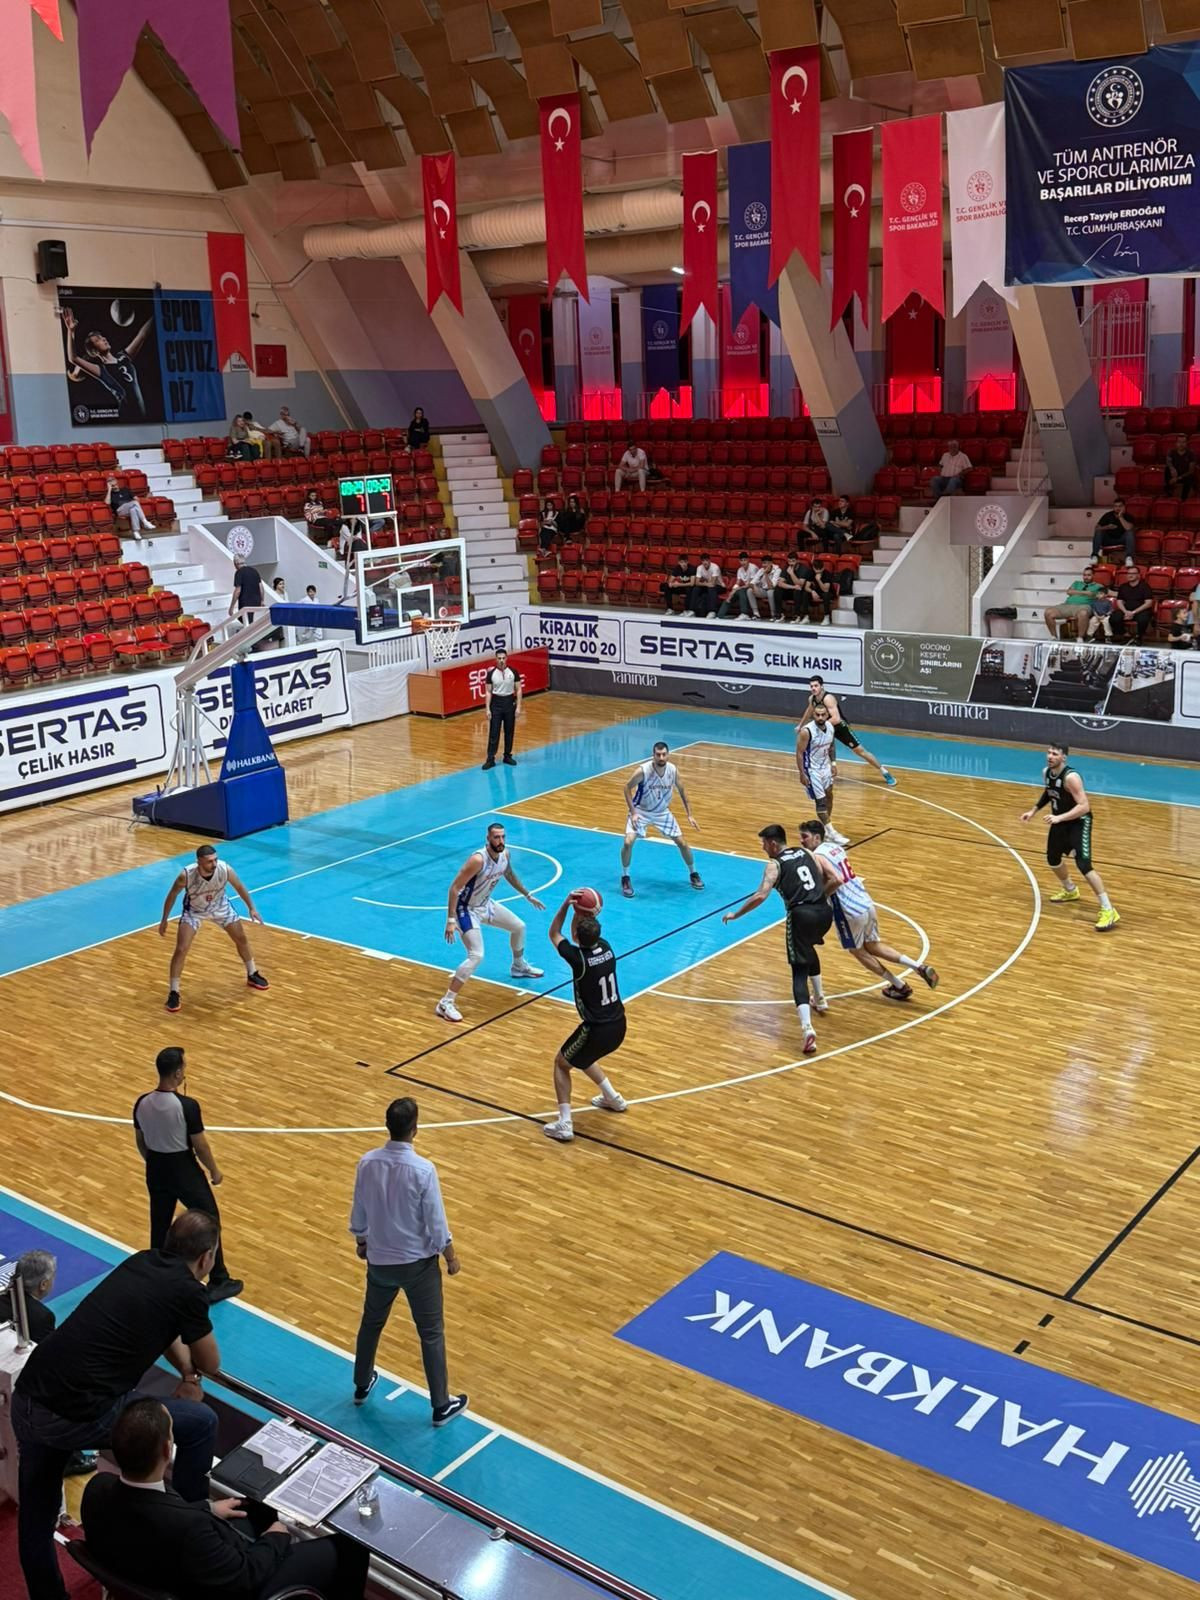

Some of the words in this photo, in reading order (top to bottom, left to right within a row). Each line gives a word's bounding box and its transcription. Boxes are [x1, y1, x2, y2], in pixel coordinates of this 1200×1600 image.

[1053, 148, 1088, 167] TÜM
[1092, 138, 1178, 163] ANTRENÖR
[1037, 169, 1055, 184] VE
[1058, 154, 1196, 183] SPORCULARIMIZA
[1040, 179, 1113, 202] BAŞARILAR
[1115, 173, 1193, 193] DİLİYORUM
[956, 214, 972, 222] SPOR
[973, 207, 1007, 220] BAKANLIĞ
[968, 201, 997, 212] GENÇLİK
[1064, 214, 1089, 224] Recep
[1089, 211, 1119, 223] Tayyip
[1120, 205, 1166, 217] ERDOĞAN
[889, 224, 906, 232] SPOR
[906, 219, 938, 230] BAKANLIĞI
[902, 213, 928, 223] GENÇLİK
[1066, 226, 1081, 236] T.C.
[1082, 218, 1163, 234] CUMHURBAŞKANI
[745, 231, 769, 240] GENÇLİK
[161, 299, 202, 332] SPOR
[525, 637, 553, 650] 0532
[555, 639, 577, 653] 217
[579, 640, 598, 655] 00
[600, 642, 617, 656] 20
[640, 635, 755, 665] SERTAŞ
[764, 650, 800, 669] ÇELİK
[802, 656, 843, 672] HASIR
[870, 637, 885, 651] GYM
[920, 642, 951, 652] GÜCÜNÜ
[920, 660, 962, 669] SINIRLARINI
[262, 696, 314, 719] TİCARET
[18, 751, 65, 779] ÇELİK
[68, 742, 115, 766] HASIR
[236, 752, 276, 769] HALKBANK
[797, 865, 815, 891] 9
[598, 972, 618, 1007] 11
[684, 1289, 1130, 1485] HALKBANK
